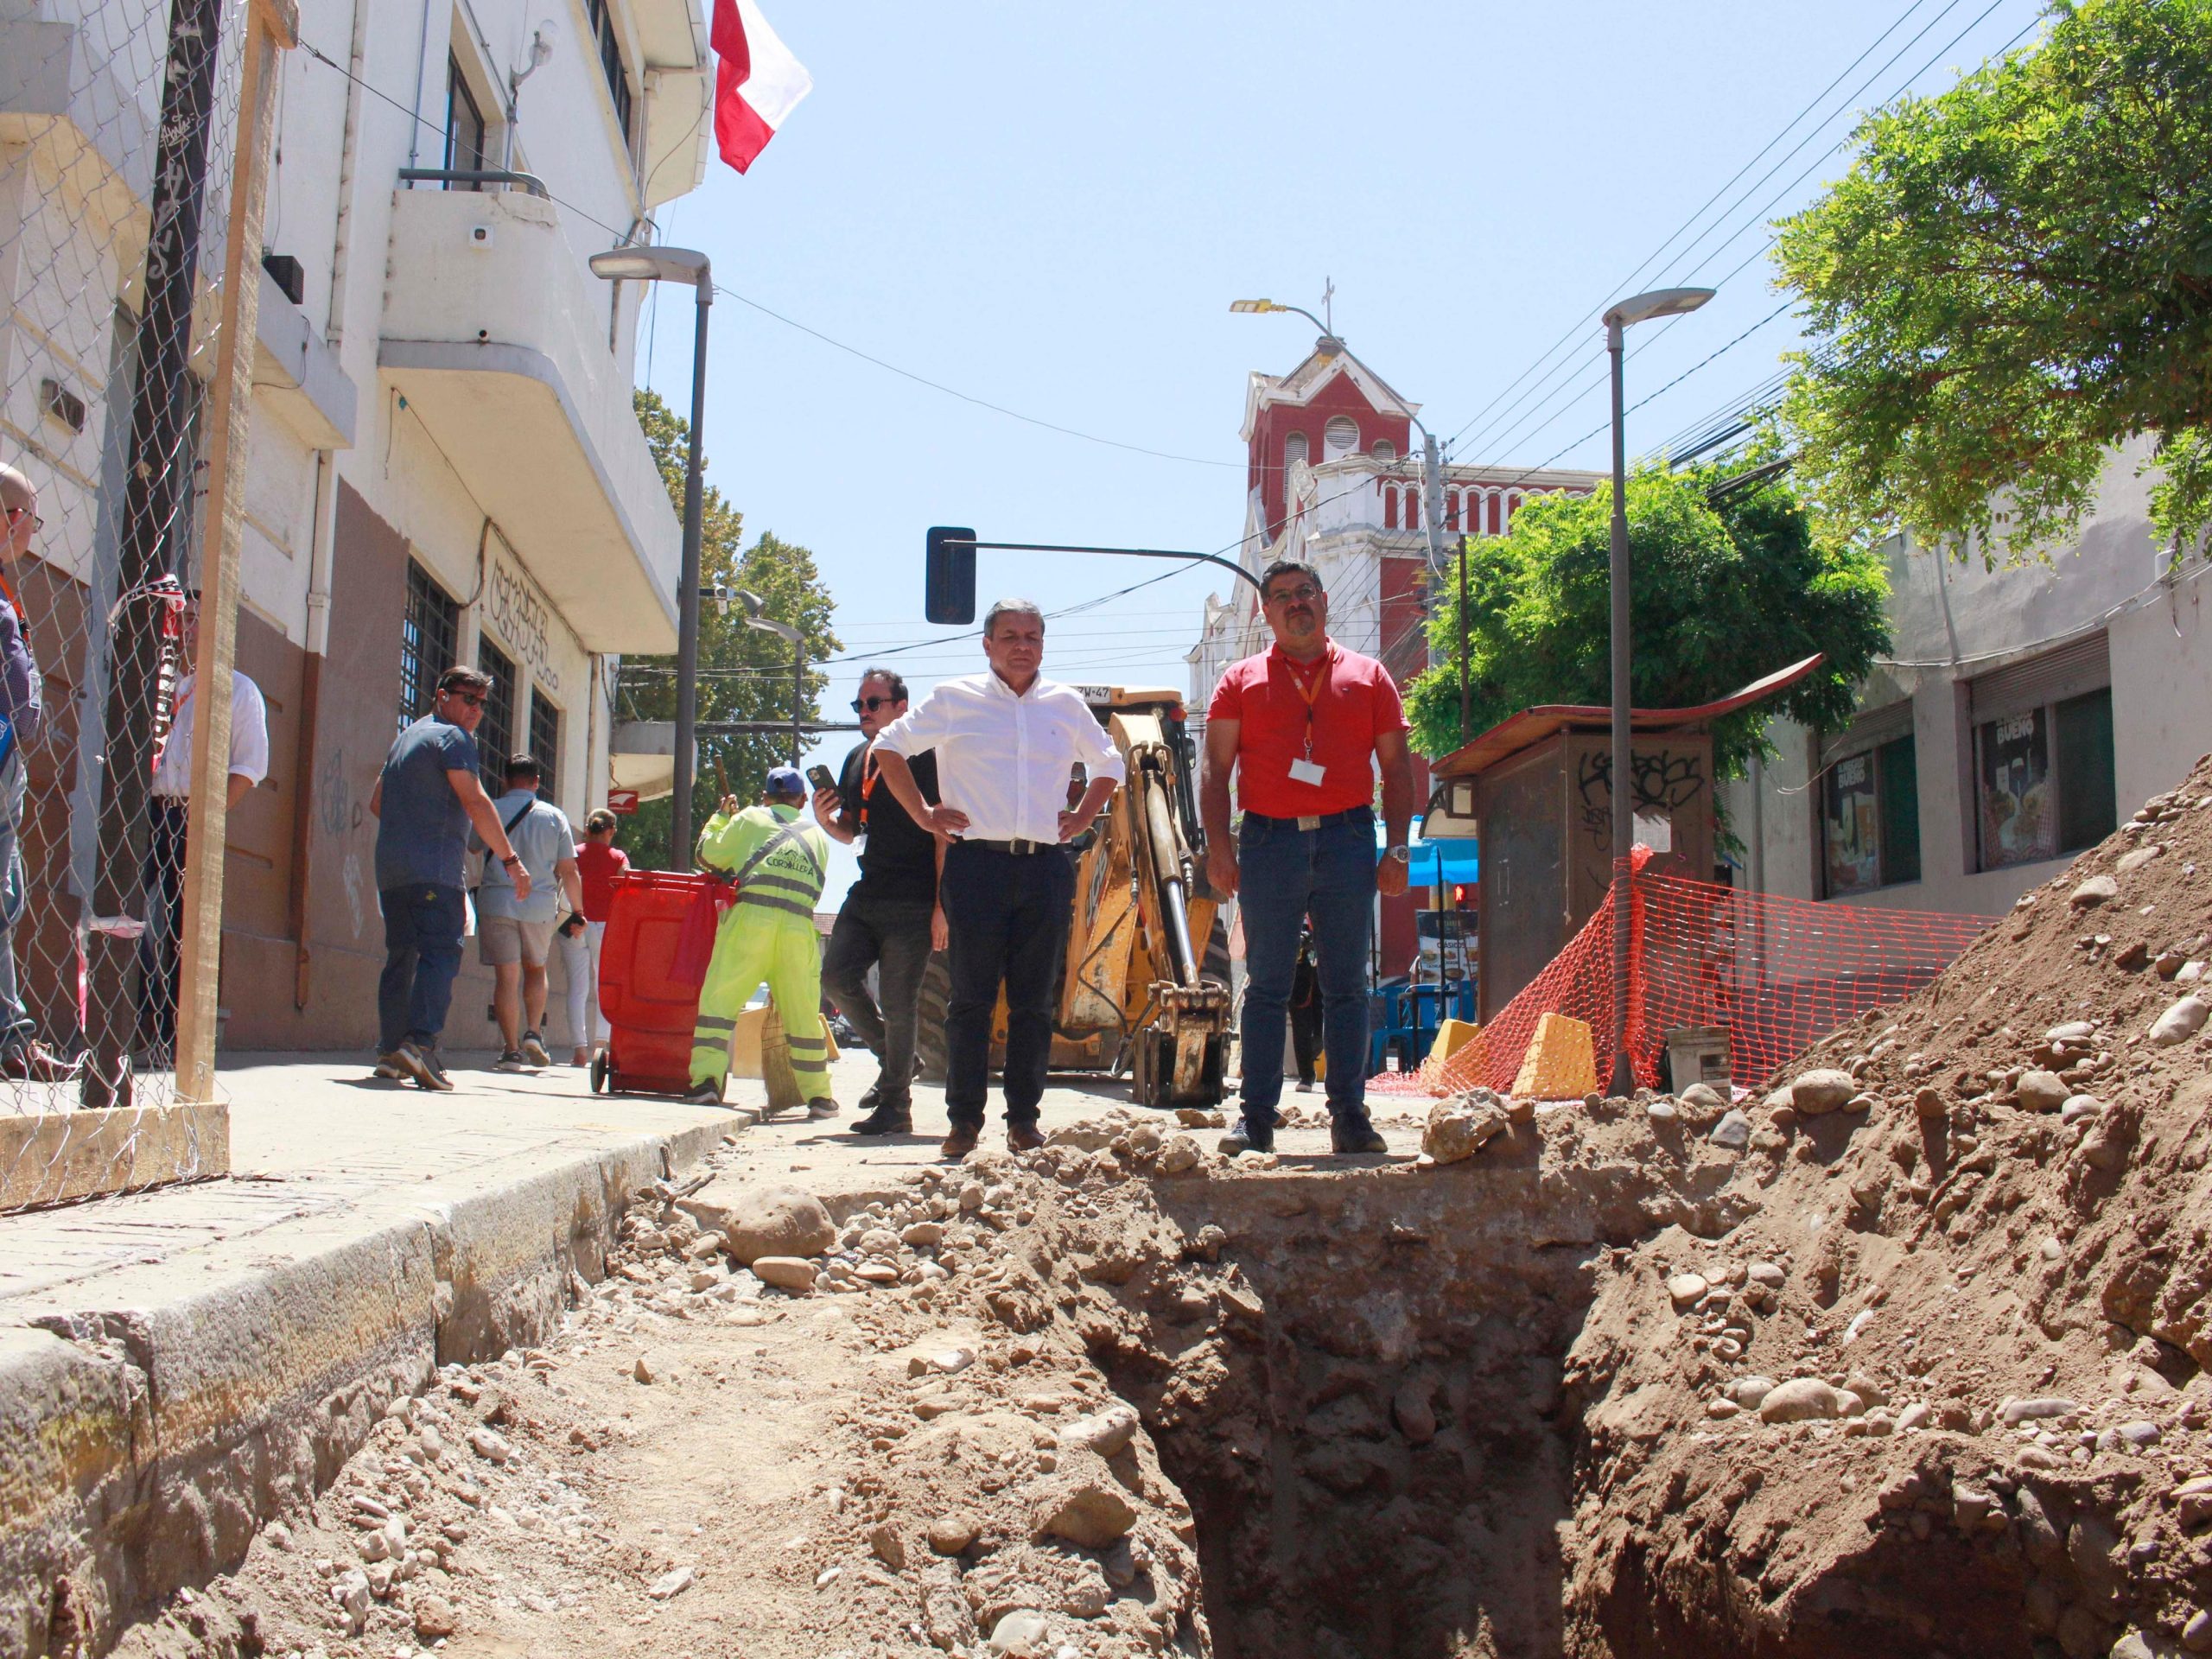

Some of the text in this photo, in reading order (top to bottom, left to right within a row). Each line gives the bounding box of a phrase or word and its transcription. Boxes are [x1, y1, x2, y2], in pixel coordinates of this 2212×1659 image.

[1997, 719, 2034, 745] BUENO
[1838, 767, 1866, 788] BUENO
[1086, 845, 1108, 927] JCB
